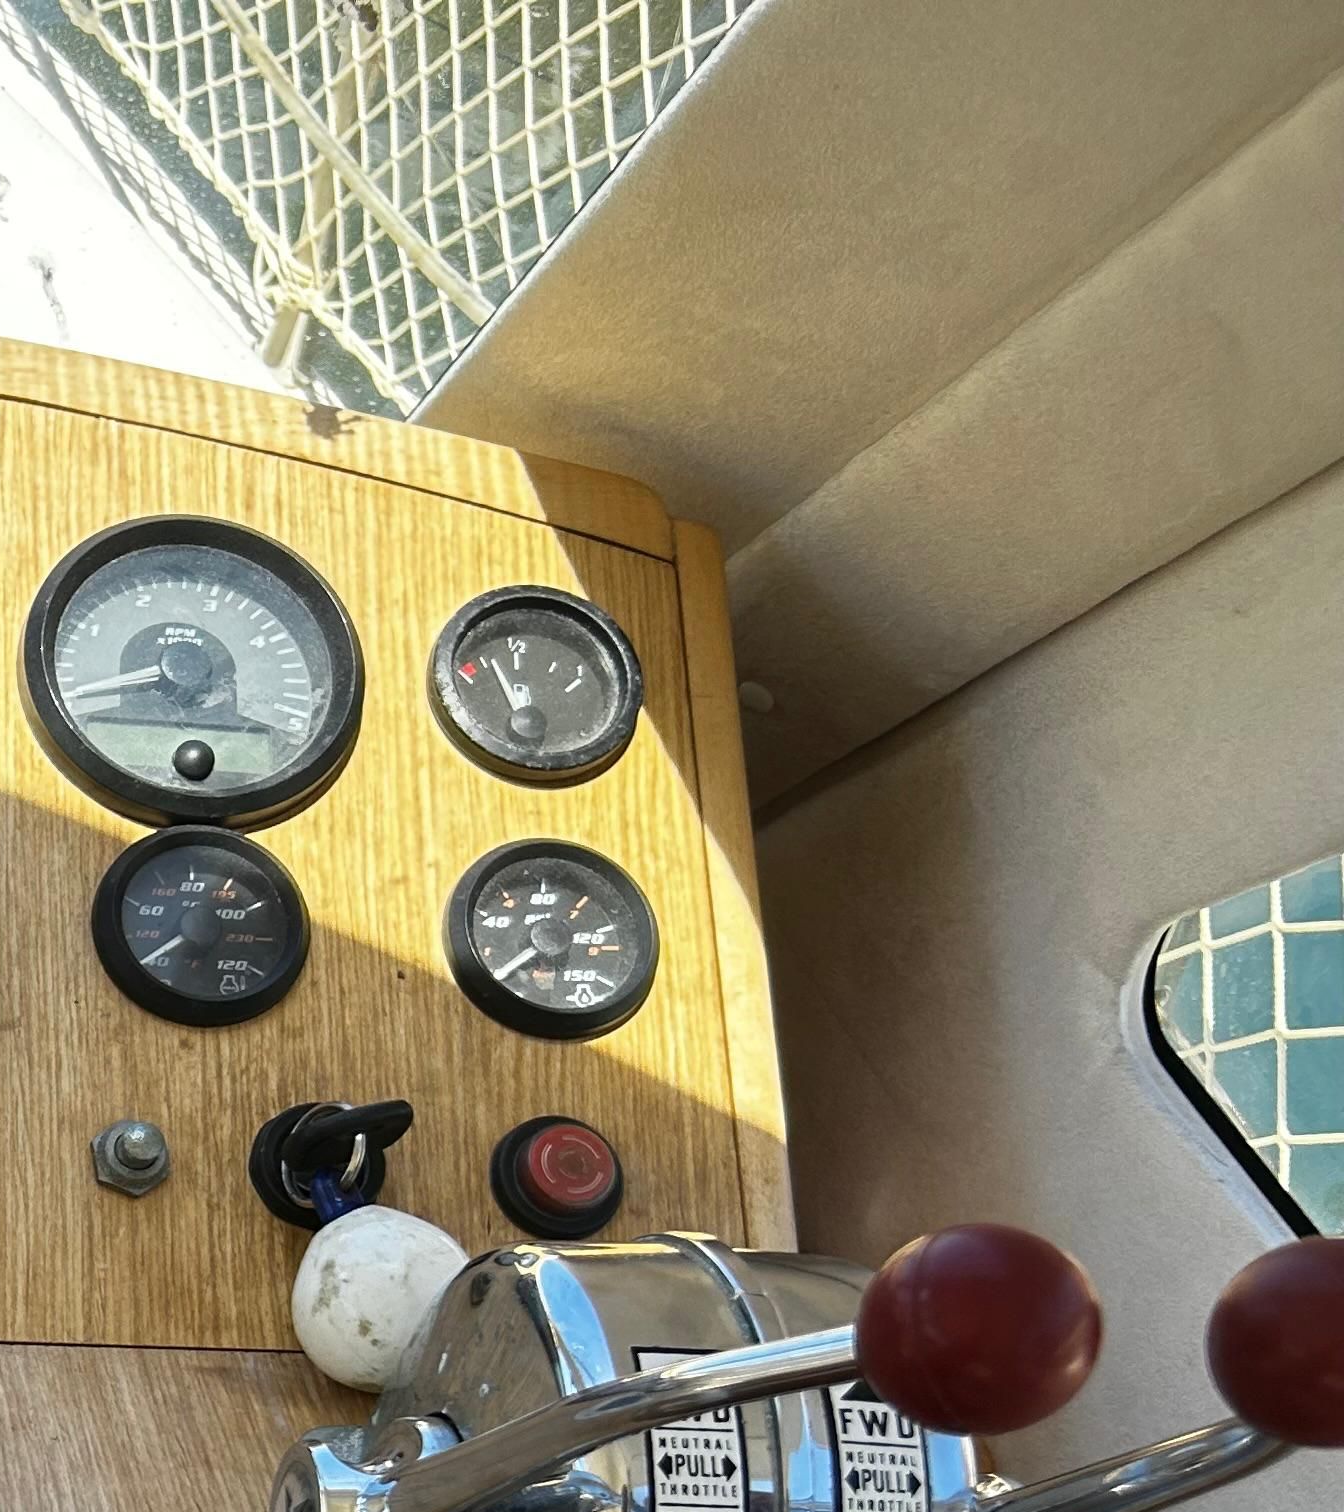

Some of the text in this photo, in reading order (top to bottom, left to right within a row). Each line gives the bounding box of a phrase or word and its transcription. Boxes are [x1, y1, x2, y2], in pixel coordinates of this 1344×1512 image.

[135, 594, 153, 607] 2
[202, 599, 218, 612] 3
[90, 623, 100, 637] 1
[165, 627, 196, 637] RPM
[249, 635, 266, 648] 4
[287, 717, 303, 731] 5
[179, 881, 206, 893] 80
[529, 893, 557, 906] 80
[138, 905, 165, 917] 60
[482, 915, 510, 928] 40
[135, 930, 161, 939] 120
[224, 934, 254, 944] 230
[572, 932, 605, 945] 120
[216, 959, 248, 971] 120
[563, 970, 597, 982] 150
[838, 1408, 915, 1440] FWD
[658, 1436, 733, 1451] NEUTRAL
[845, 1450, 918, 1467] NEUTRAL
[675, 1453, 721, 1478] PULL
[862, 1468, 906, 1493] PULL
[660, 1482, 738, 1498] THROTTLE
